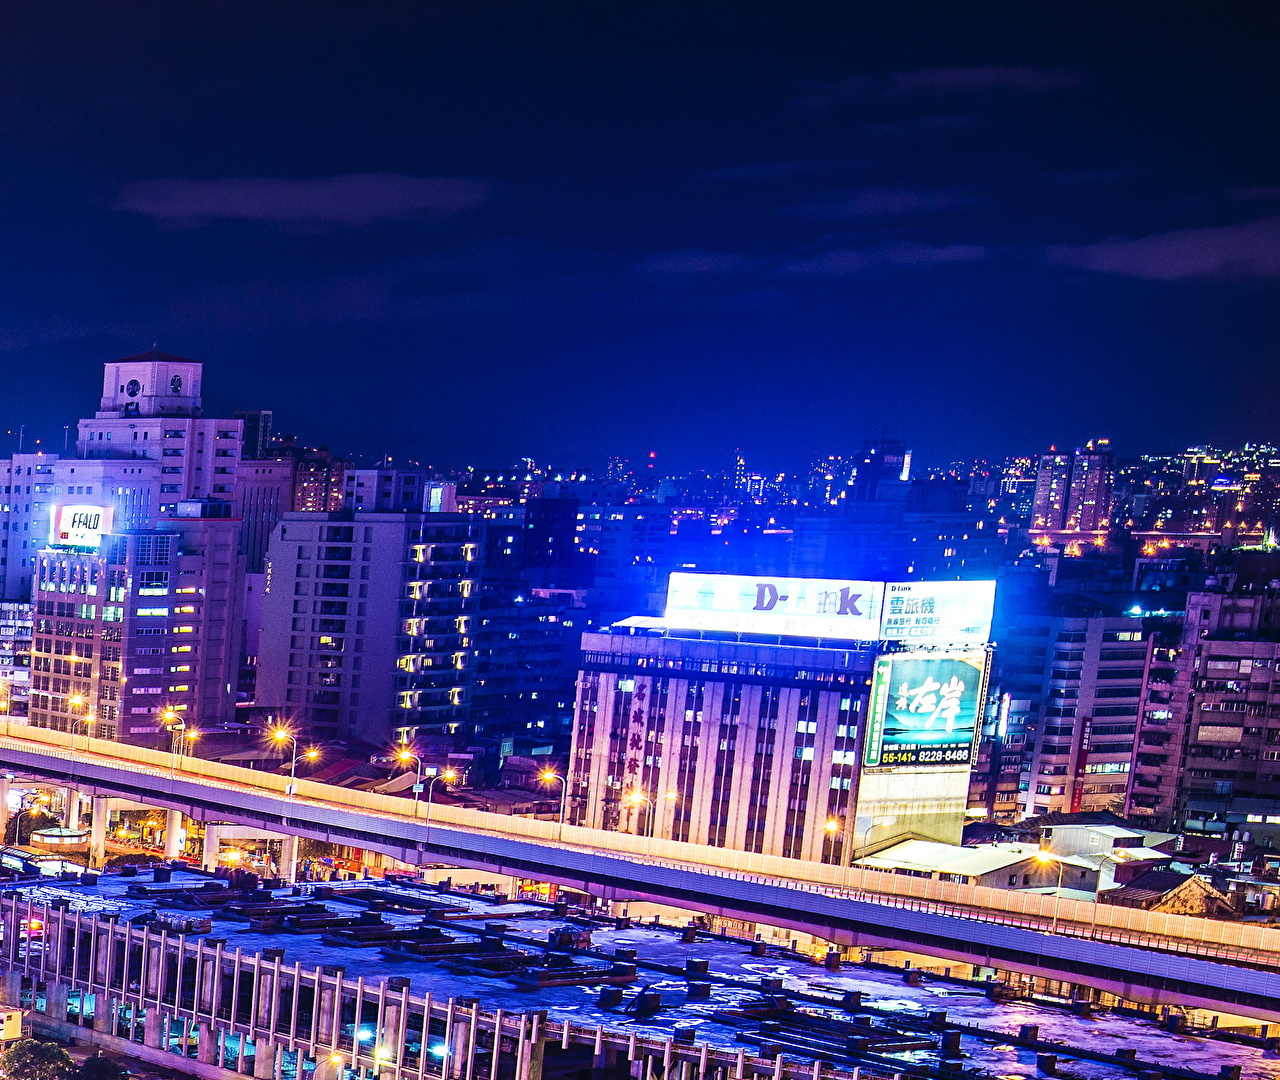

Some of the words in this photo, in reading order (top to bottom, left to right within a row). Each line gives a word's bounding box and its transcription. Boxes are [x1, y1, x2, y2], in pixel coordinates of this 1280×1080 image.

[890, 596, 935, 615] 雲旅機
[908, 676, 966, 734] 左岸
